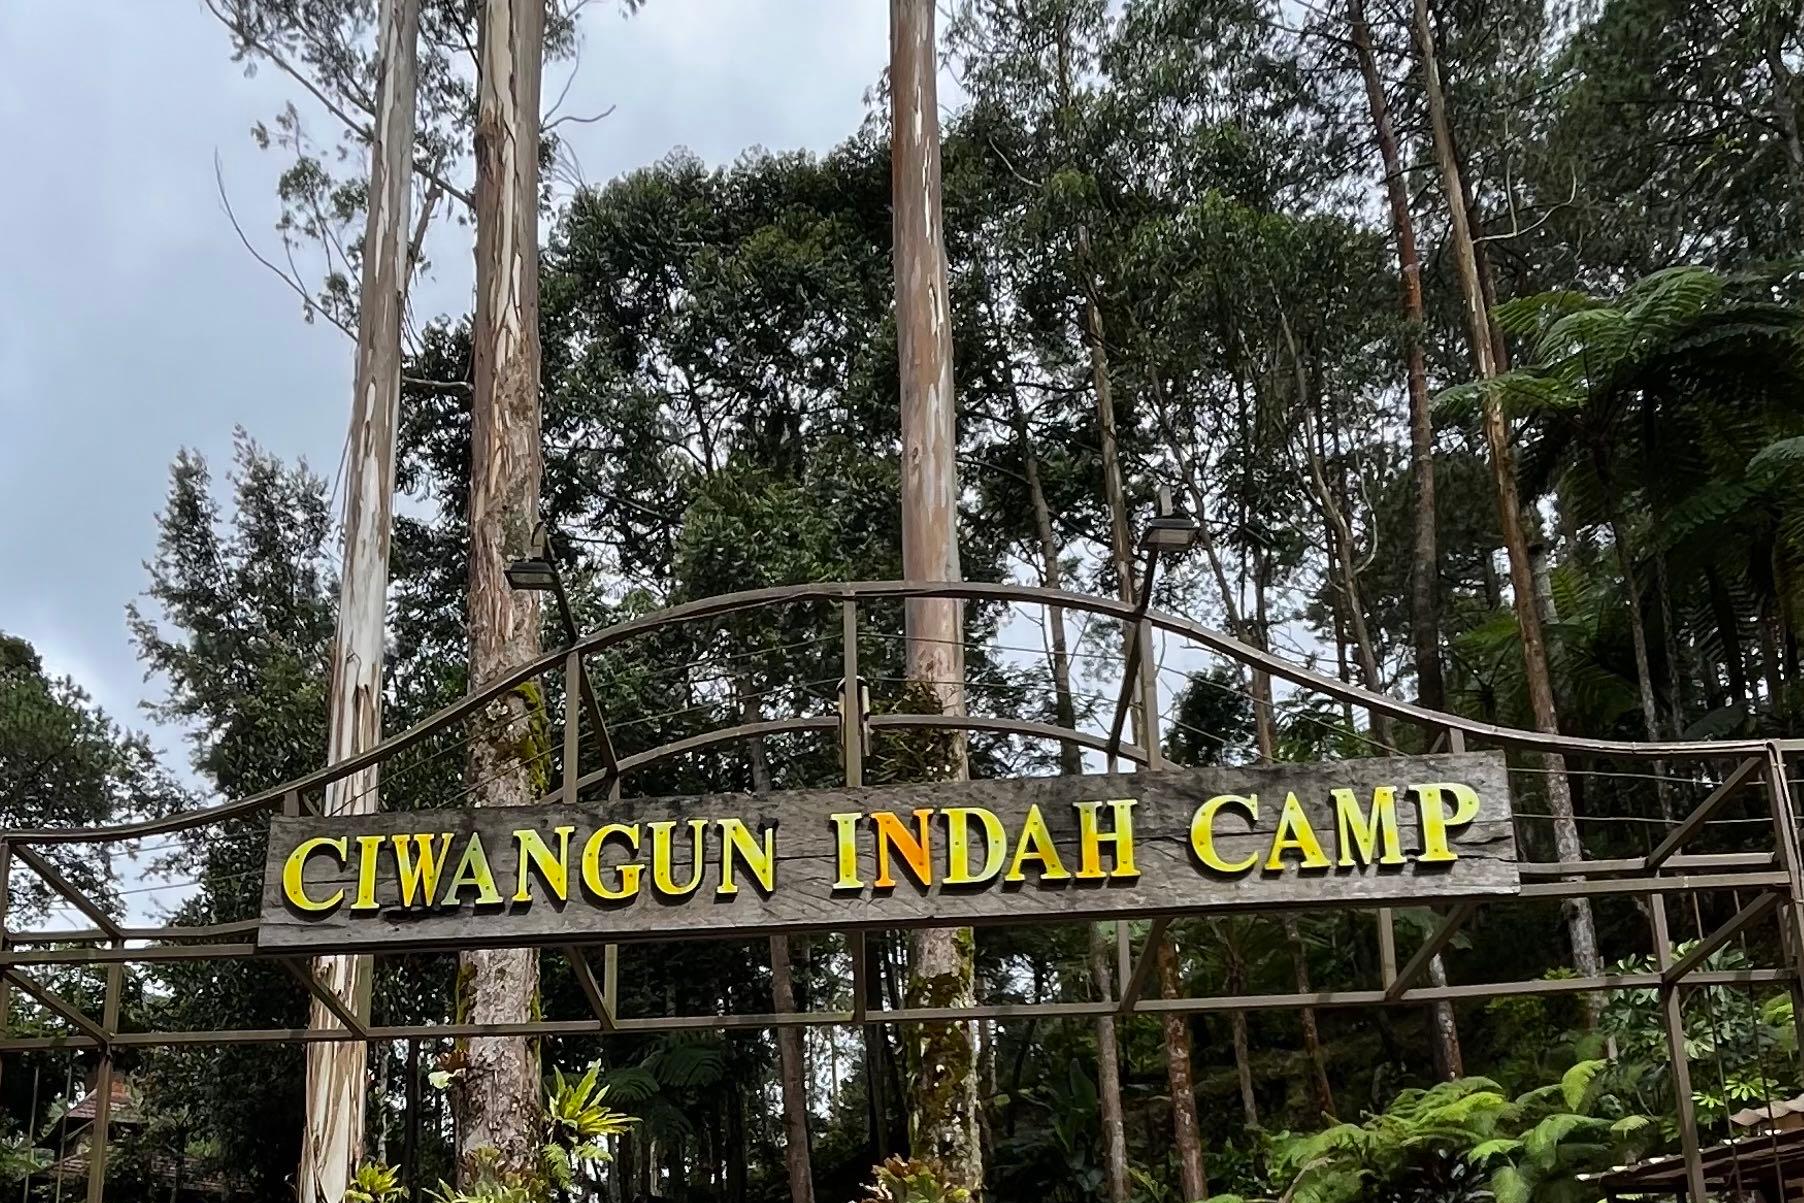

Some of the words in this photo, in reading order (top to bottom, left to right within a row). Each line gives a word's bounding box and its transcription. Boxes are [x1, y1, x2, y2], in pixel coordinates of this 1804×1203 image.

[282, 816, 778, 912] CIWANGUN
[829, 798, 1139, 890] INDAH
[1189, 781, 1481, 874] CAMP
